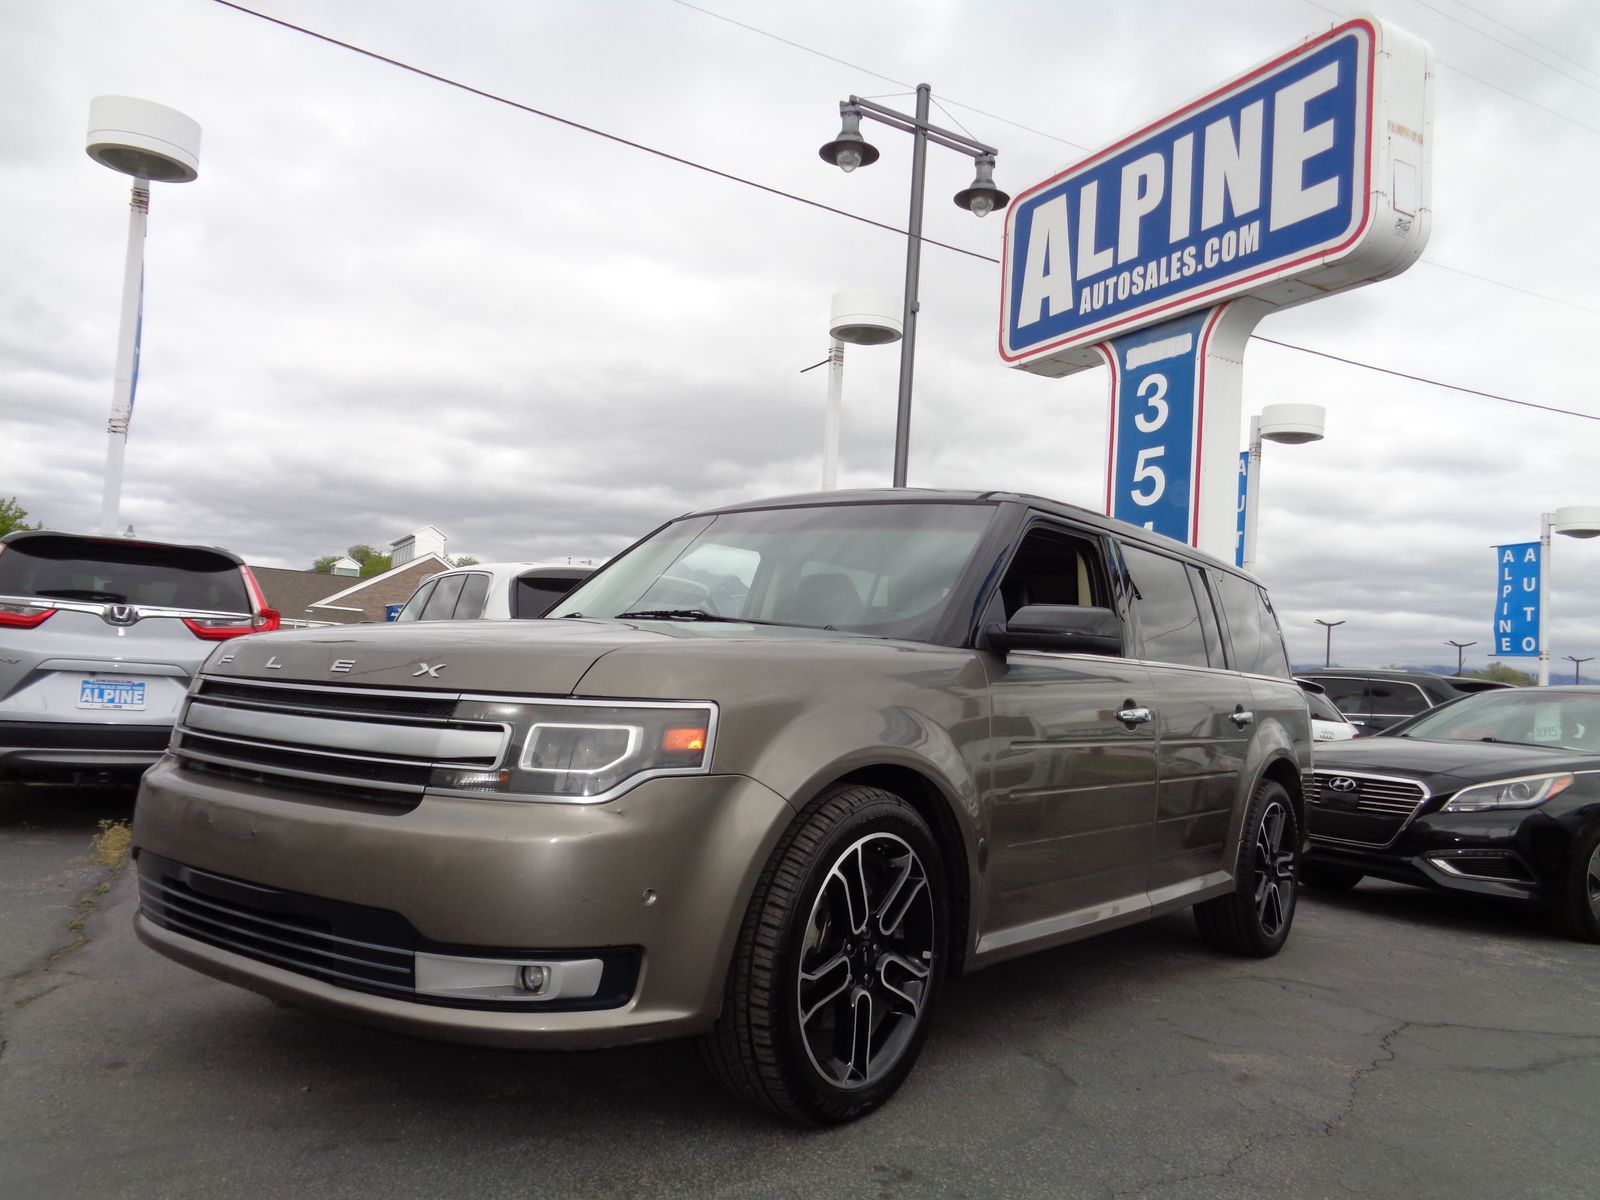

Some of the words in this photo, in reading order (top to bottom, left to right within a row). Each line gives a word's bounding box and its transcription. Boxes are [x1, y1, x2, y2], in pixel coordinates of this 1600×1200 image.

[1017, 60, 1340, 329] ALPINE
[1079, 220, 1261, 315] AUTOSALES.COM
[1131, 373, 1169, 531] 35
[1500, 550, 1514, 651] ALPINE
[1521, 548, 1536, 652] AUTO
[81, 688, 144, 704] ALPINE
